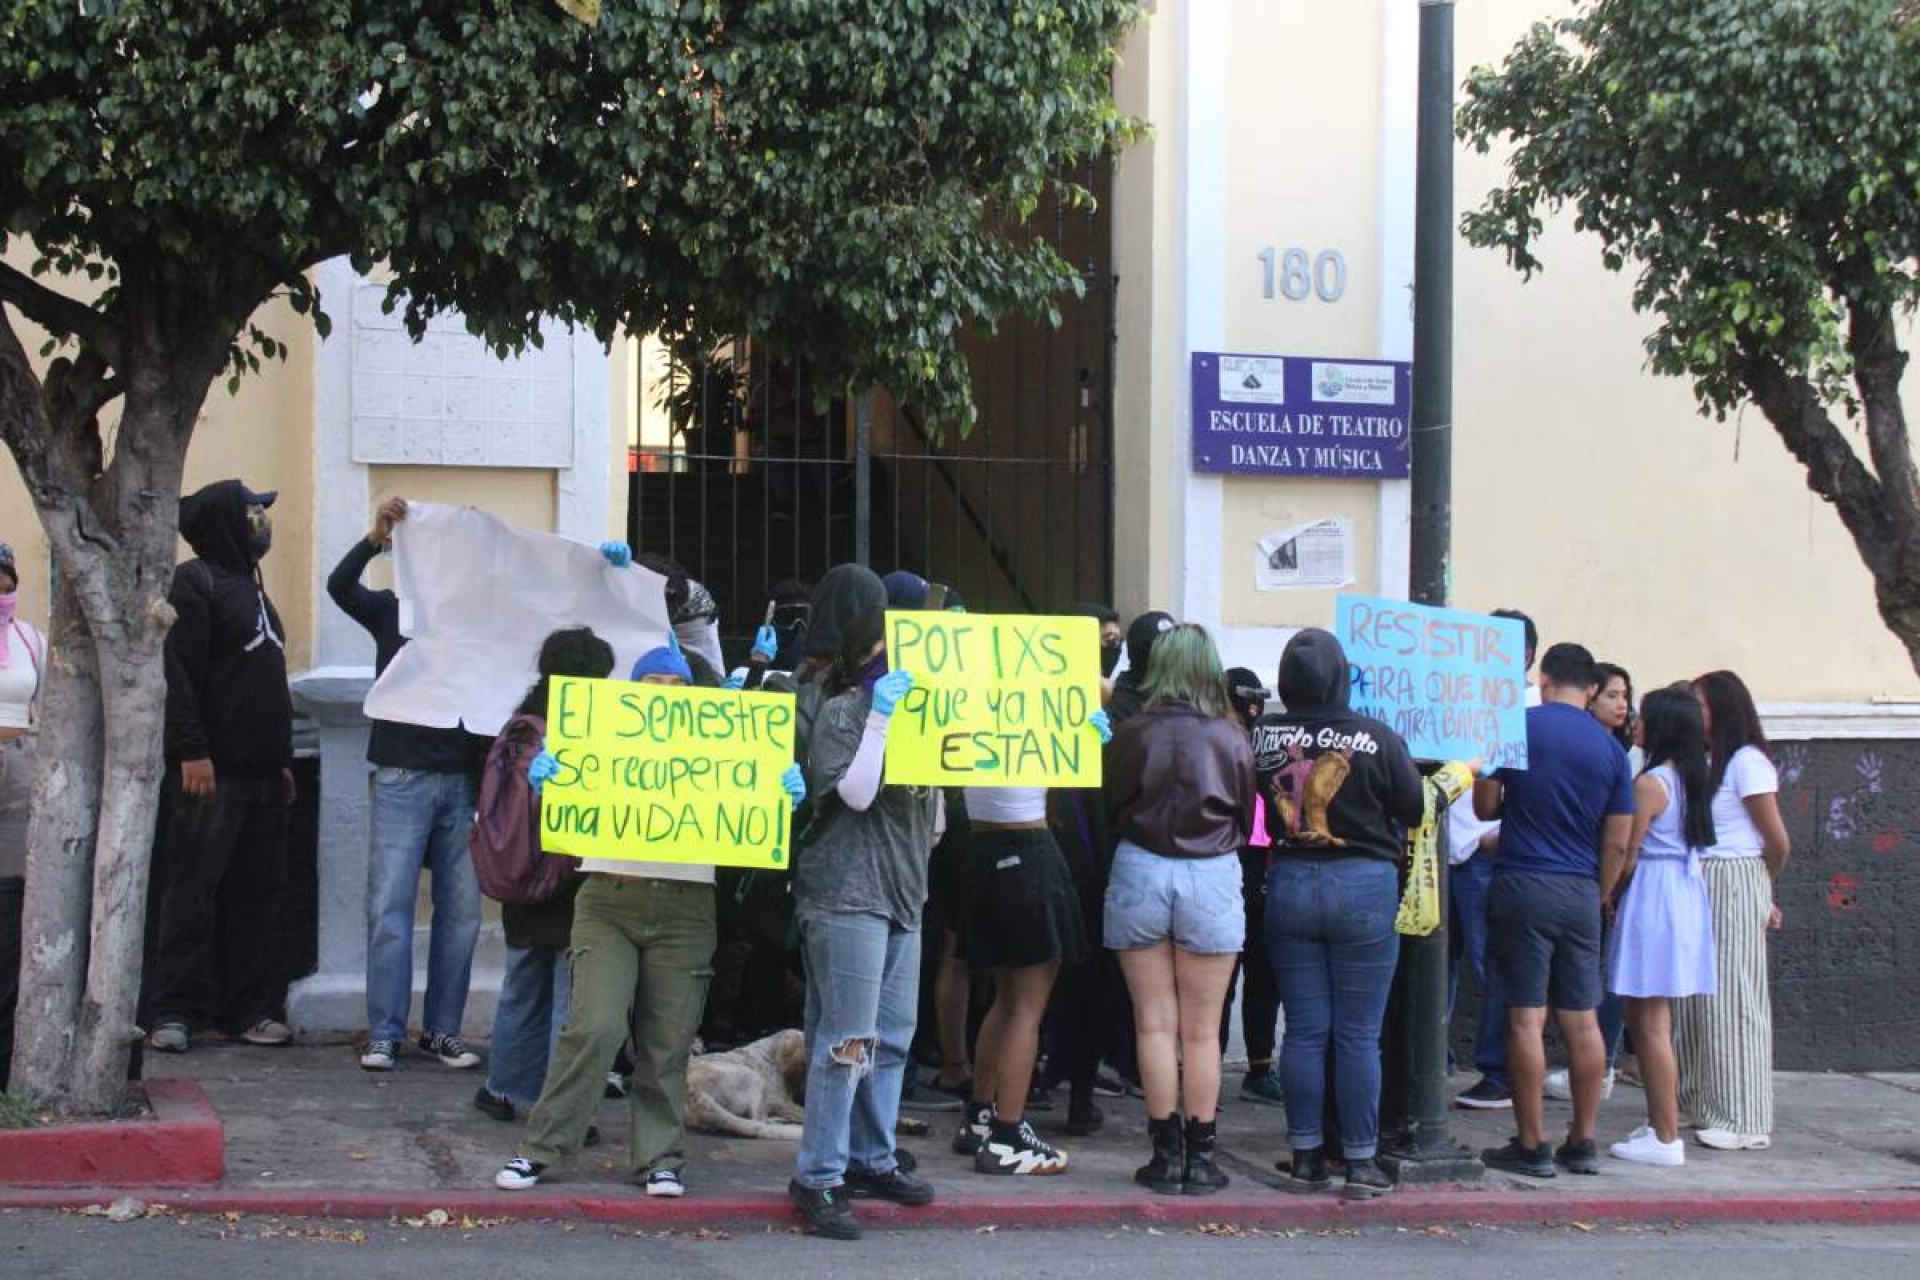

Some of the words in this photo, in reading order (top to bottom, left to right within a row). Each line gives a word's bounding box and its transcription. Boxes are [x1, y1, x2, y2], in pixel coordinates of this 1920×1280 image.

[1257, 246, 1347, 303] 180
[1210, 411, 1292, 434] ESCUELA
[1298, 414, 1324, 435] DE
[1329, 415, 1402, 438] TEATRO
[1231, 445, 1293, 468] DANZA
[1297, 447, 1311, 468] Y
[1314, 445, 1383, 470] MÚSICA
[1350, 603, 1511, 665] RESISTIR
[986, 688, 1026, 731] ya
[1042, 685, 1087, 732] NO
[1348, 664, 1415, 705] PARA
[1425, 671, 1474, 705] QUE
[1481, 678, 1518, 710] NO
[940, 729, 1080, 777] ESTAN
[612, 756, 757, 798] recupera
[546, 803, 600, 837] una
[612, 803, 704, 842] VIDA
